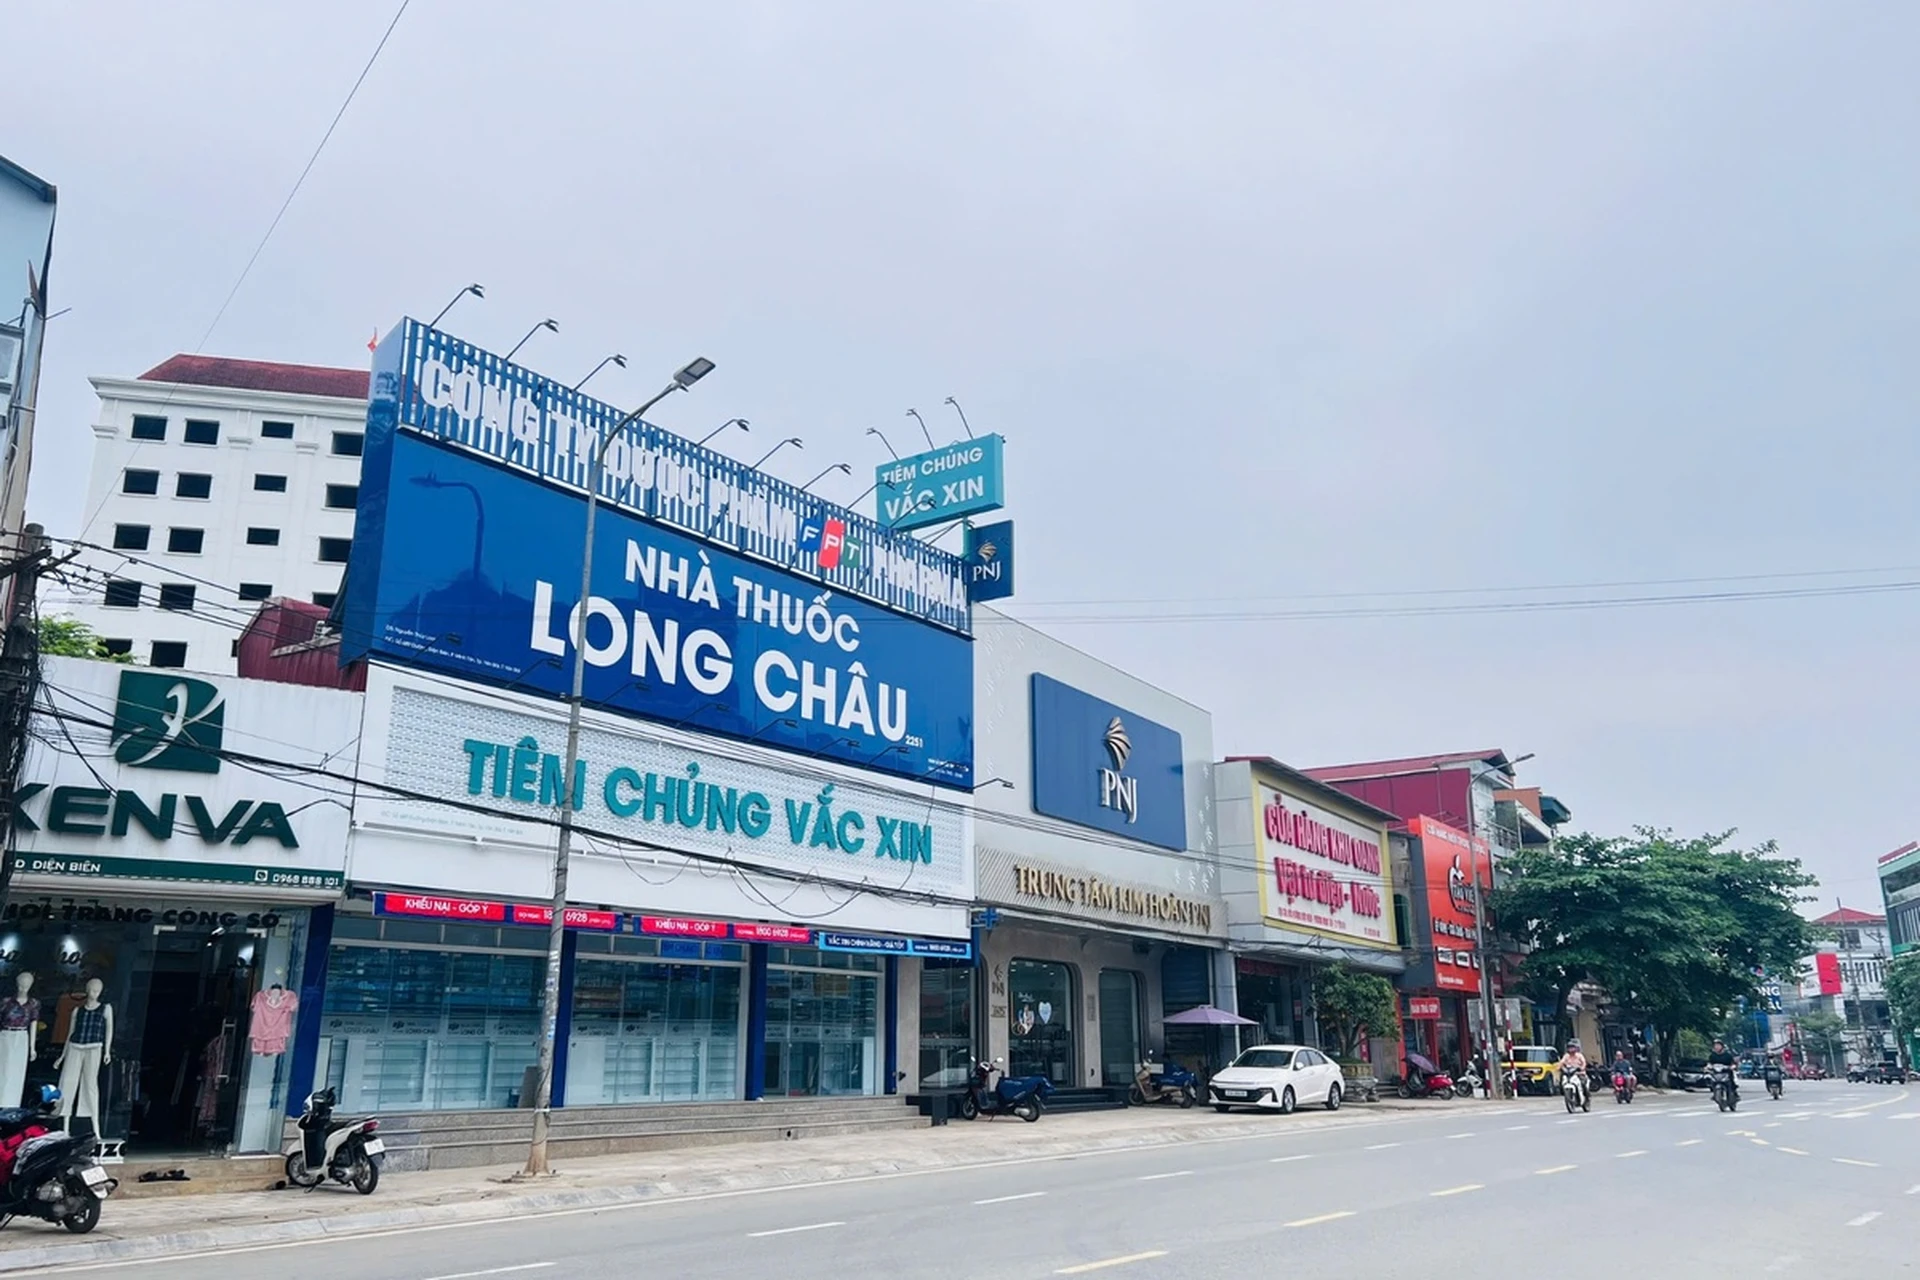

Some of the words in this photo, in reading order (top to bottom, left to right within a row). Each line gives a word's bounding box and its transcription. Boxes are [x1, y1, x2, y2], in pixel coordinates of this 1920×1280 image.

[421, 359, 541, 444] CÔNG
[551, 411, 597, 465] TY
[709, 481, 796, 547] PHẨM
[882, 464, 916, 484] TIÊM
[884, 484, 935, 520] VẮC
[942, 476, 984, 506] XIN
[625, 538, 720, 610] NHÀ
[732, 575, 860, 652] THUỐC
[973, 561, 1001, 582] PNJ
[531, 579, 733, 696] LONG
[753, 650, 907, 742] CHÂU
[13, 782, 300, 849] KENVA
[463, 735, 587, 811] TIÊM
[603, 762, 772, 838] CHỦNG
[785, 783, 865, 855] VẮC
[876, 815, 933, 865] XIN
[1101, 768, 1138, 824] PNJ
[69, 860, 102, 873] BIÊN
[405, 896, 433, 910] KHIẾU
[433, 901, 451, 915] NẠI
[458, 901, 481, 913] GÓP
[481, 901, 489, 914] Ý
[1015, 865, 1077, 903] TRUNG
[1079, 876, 1115, 909] TÂM
[1117, 886, 1145, 916] KIM
[61, 904, 154, 924] TRANG
[162, 906, 238, 928] CÔNG
[565, 911, 588, 923] 6928
